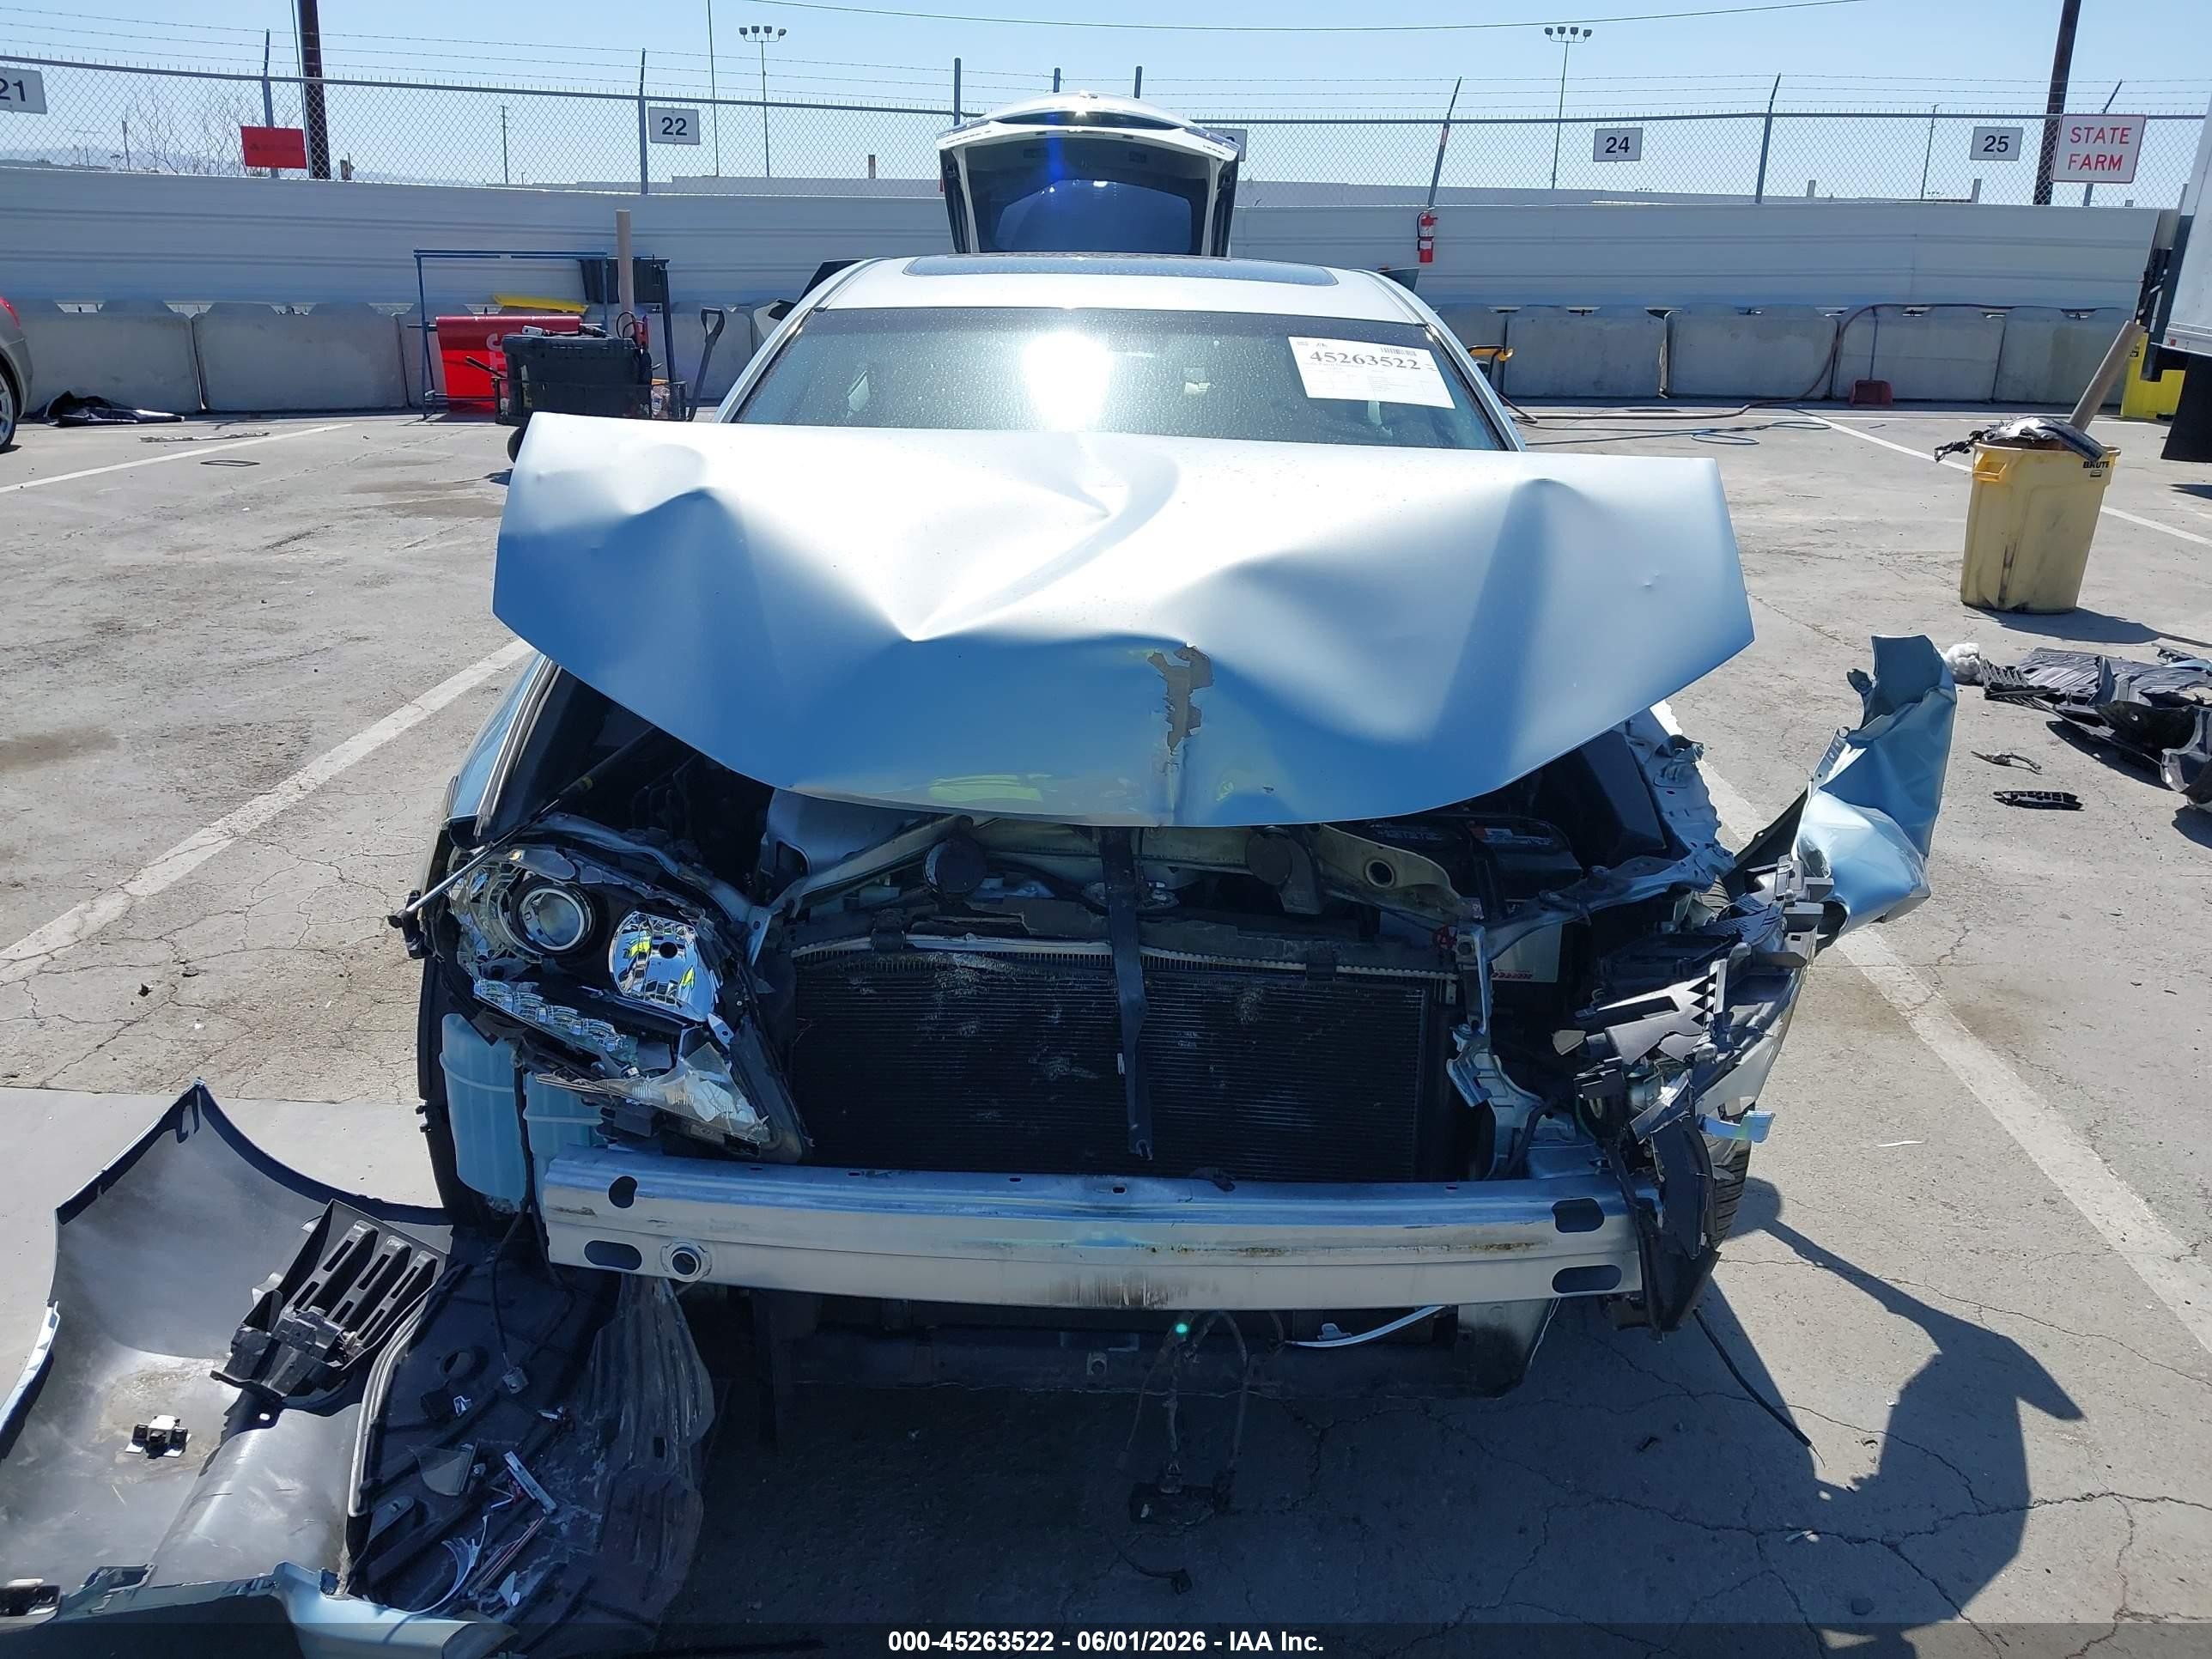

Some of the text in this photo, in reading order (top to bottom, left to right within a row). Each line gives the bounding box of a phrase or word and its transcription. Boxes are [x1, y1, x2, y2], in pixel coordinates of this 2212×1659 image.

[661, 117, 688, 137] 22
[2069, 126, 2132, 145] STATE
[1605, 136, 1630, 154] 24
[1983, 135, 2010, 154] 25
[2067, 153, 2124, 172] FARM
[1310, 350, 1421, 370] 45263522
